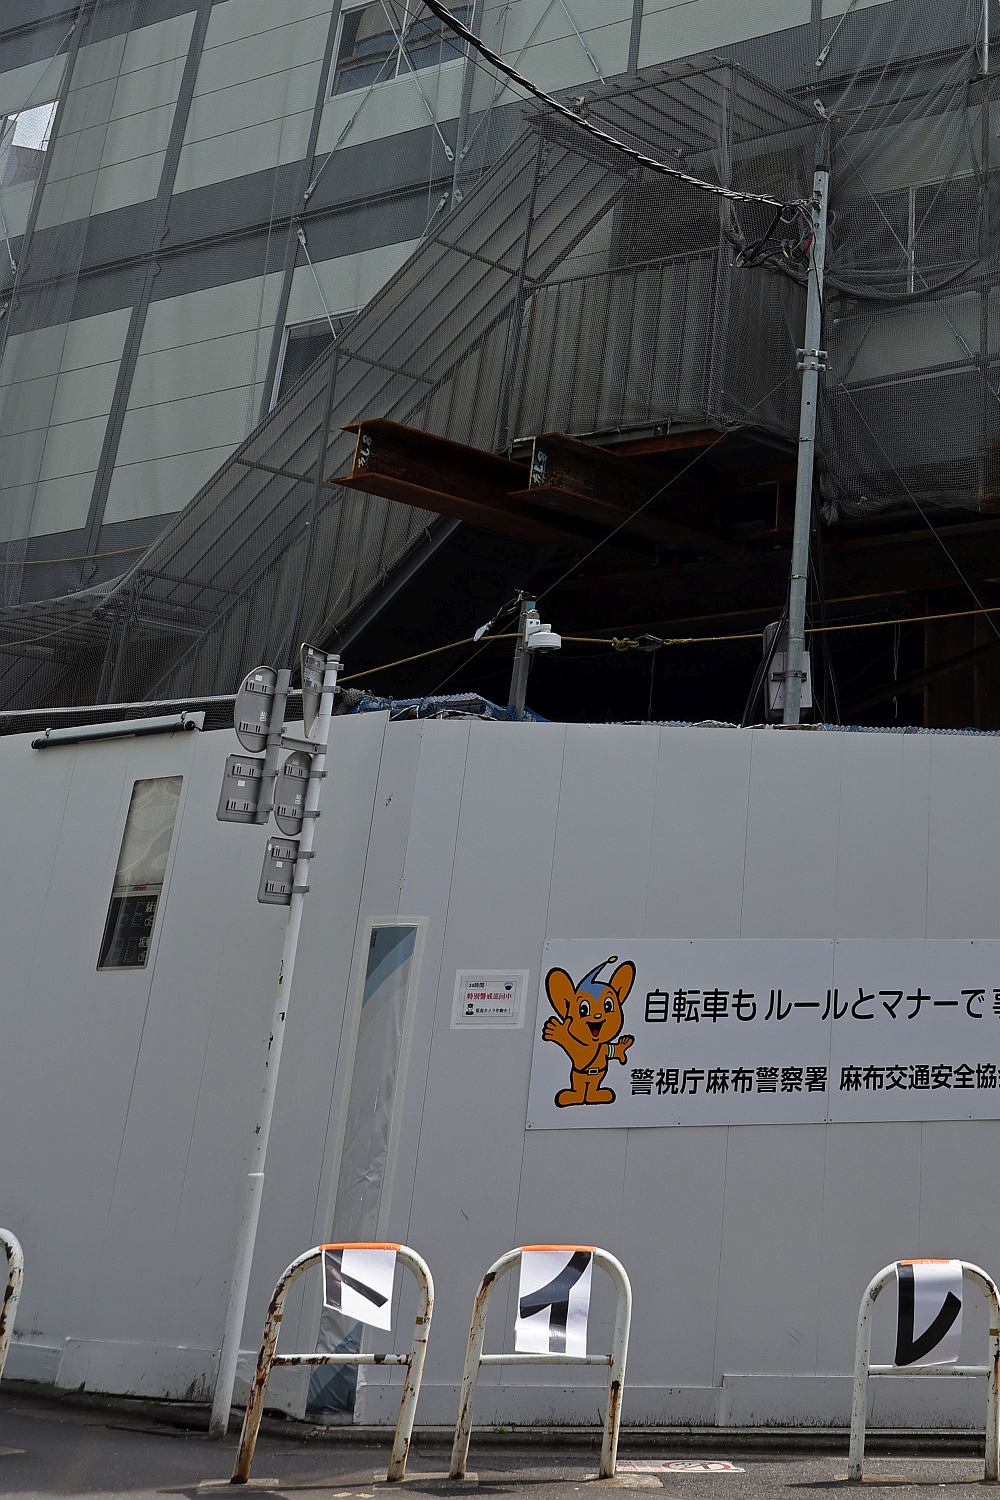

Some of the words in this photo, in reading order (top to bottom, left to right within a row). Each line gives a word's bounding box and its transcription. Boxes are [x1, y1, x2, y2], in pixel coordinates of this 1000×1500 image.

[466, 992, 512, 1000] 特別警戒巡回中
[630, 1066, 828, 1095] 警視庁麻布警察署
